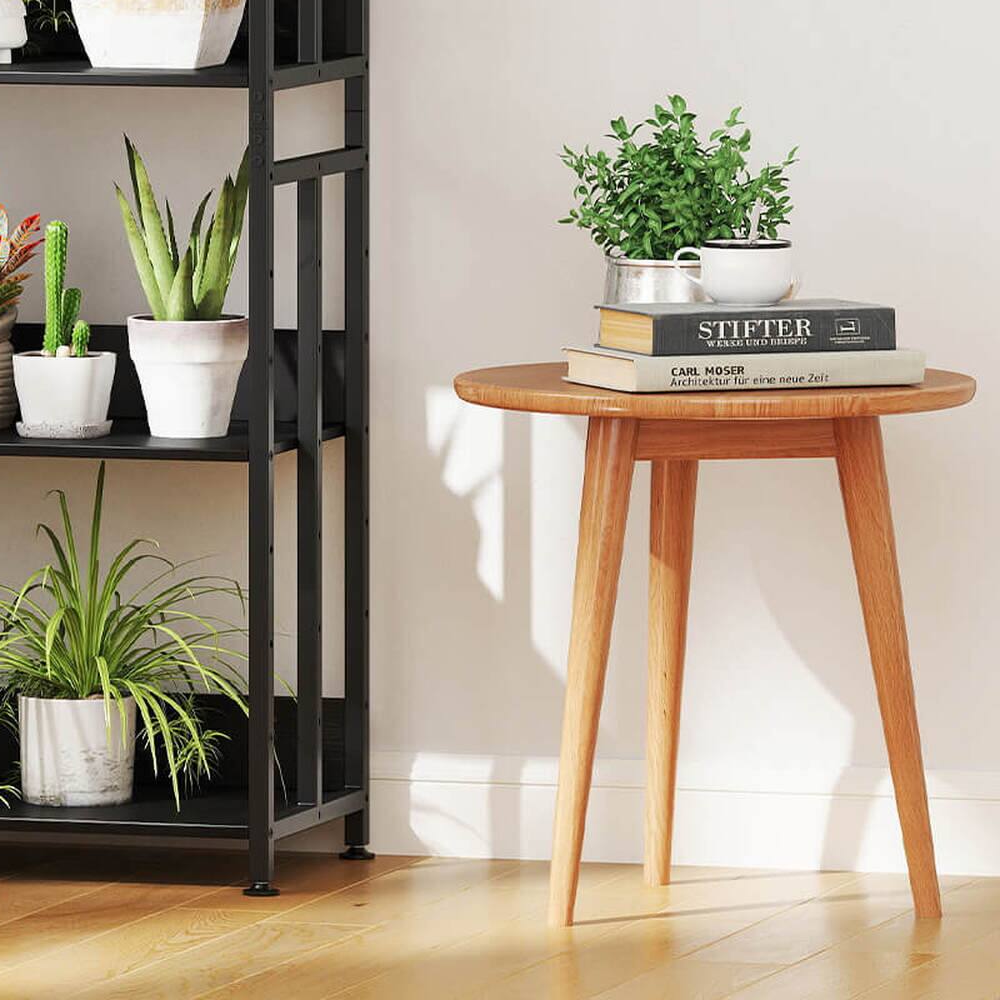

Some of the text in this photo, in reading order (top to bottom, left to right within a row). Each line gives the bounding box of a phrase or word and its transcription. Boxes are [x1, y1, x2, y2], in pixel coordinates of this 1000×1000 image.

[697, 318, 813, 340] STIFTER
[745, 338, 769, 347] UND
[670, 365, 745, 376] CARL MOSER
[670, 373, 830, 387] Architektur für eine neue Zeit
